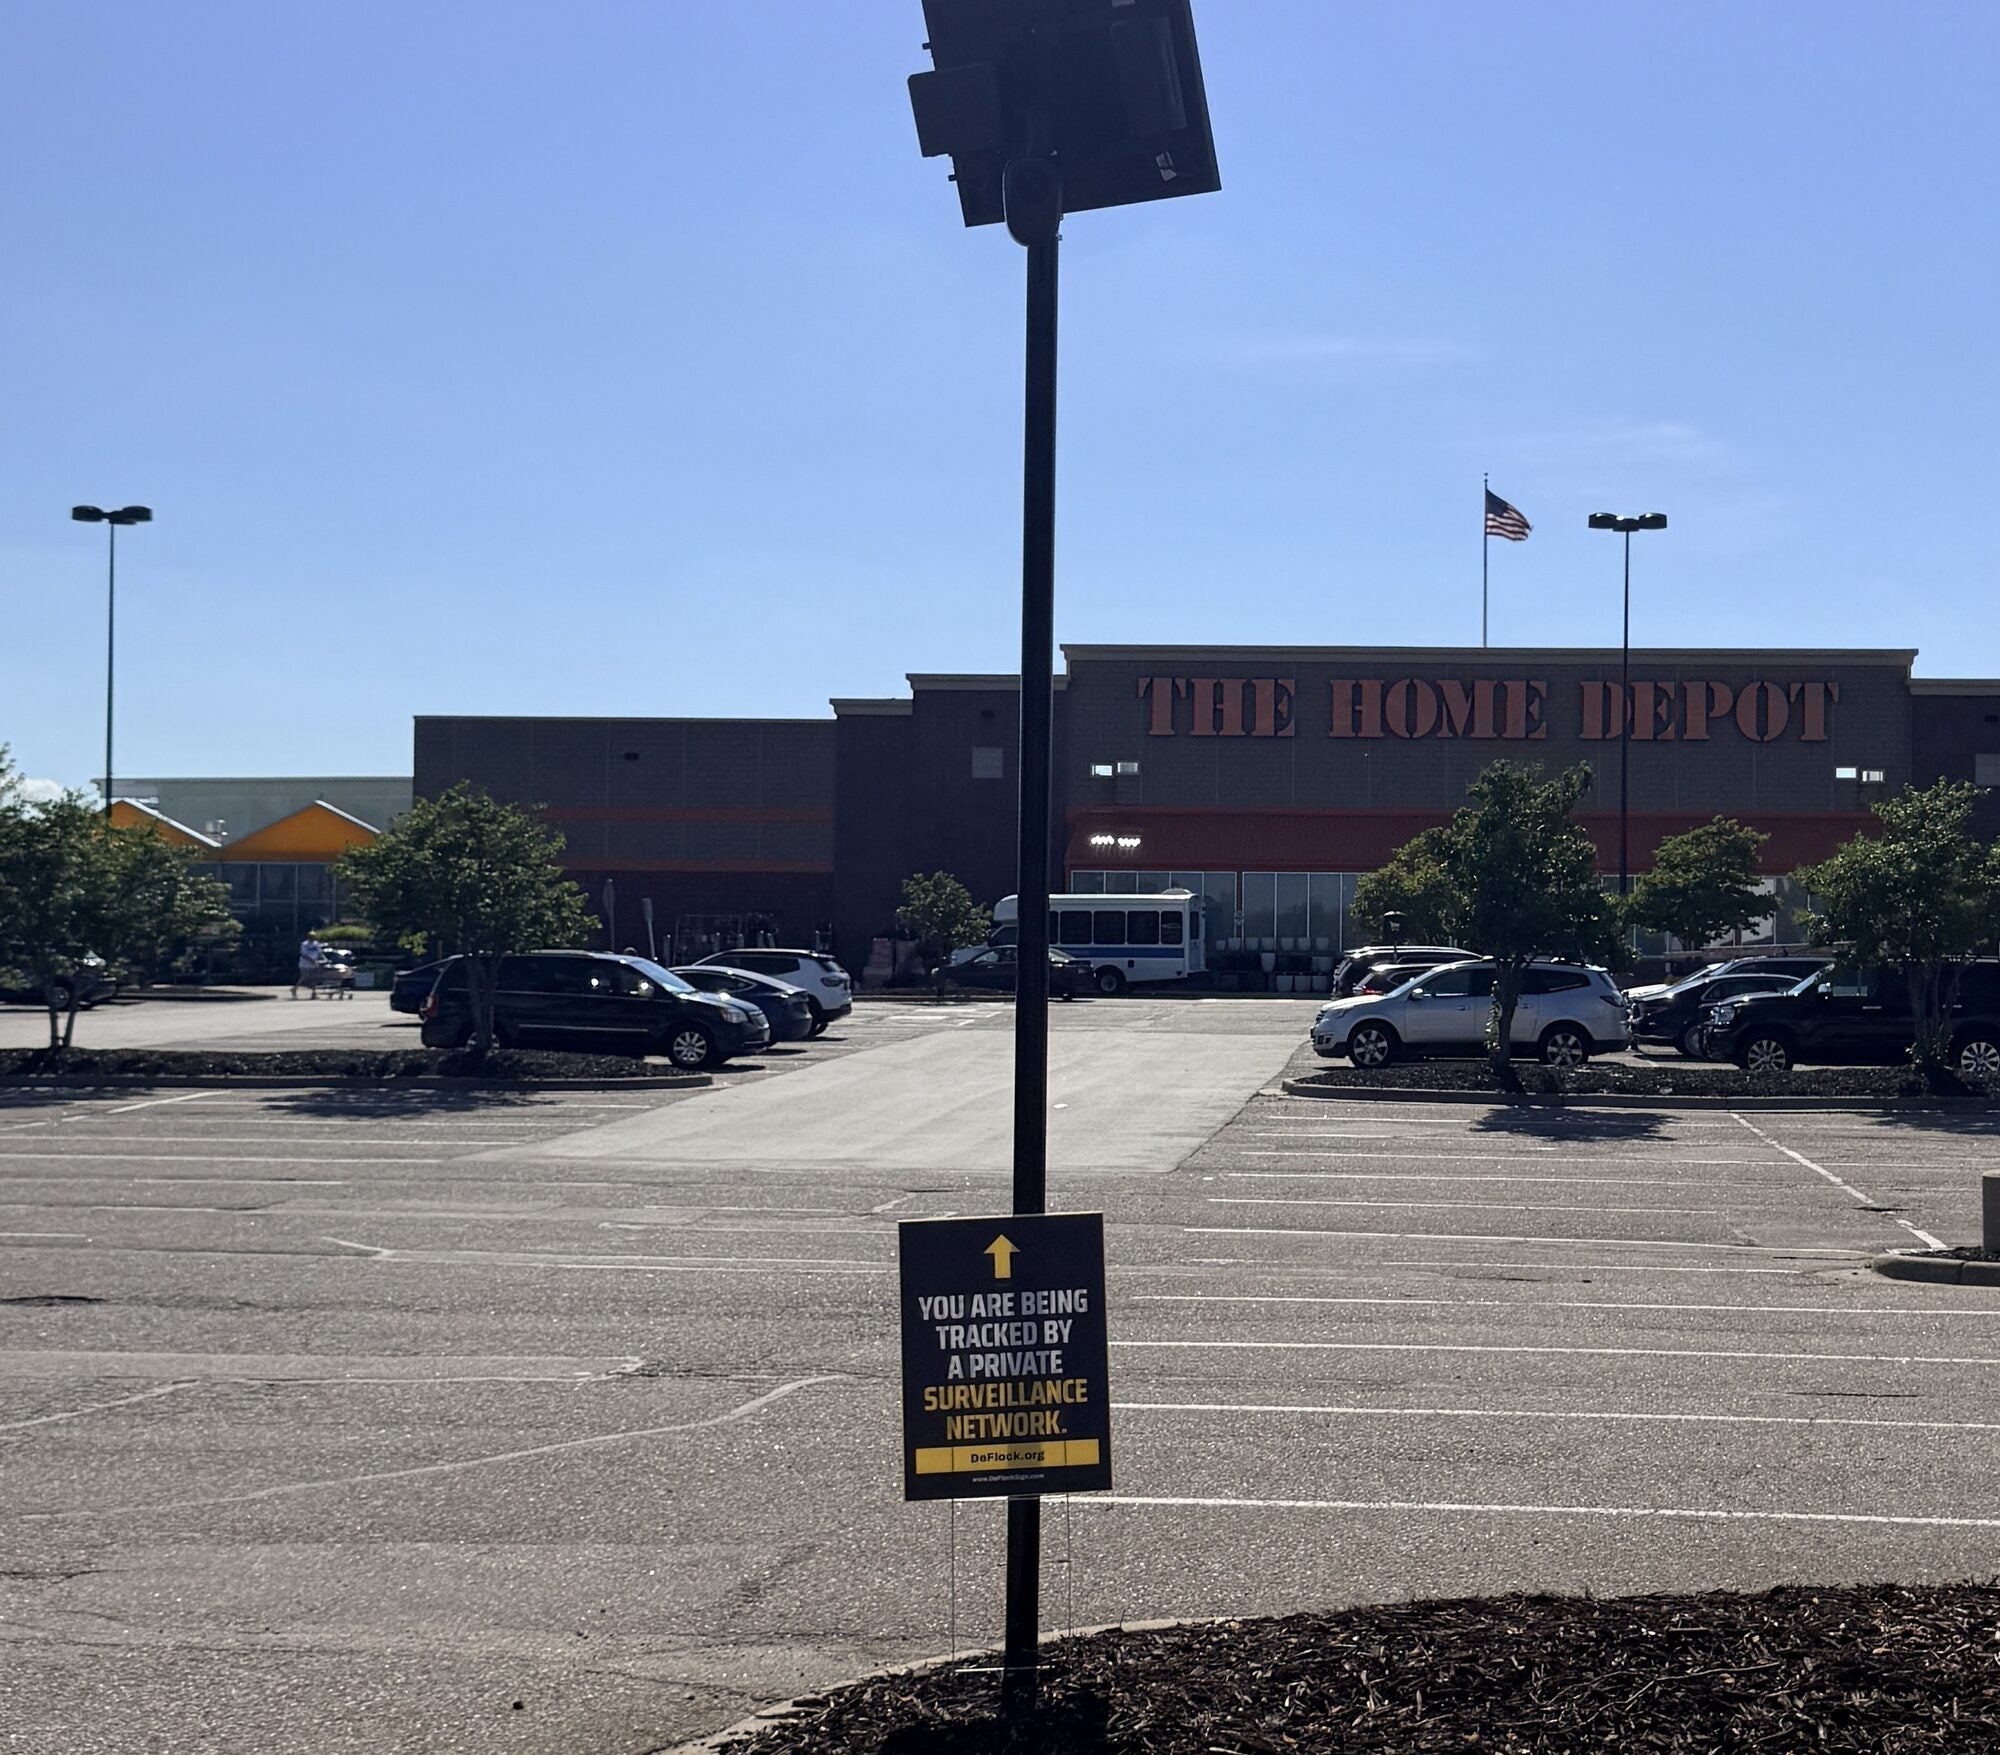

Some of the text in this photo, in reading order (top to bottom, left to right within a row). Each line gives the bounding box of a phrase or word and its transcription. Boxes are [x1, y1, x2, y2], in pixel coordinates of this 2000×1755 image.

[1138, 677, 1839, 741] THE HOME DEPOT
[918, 1289, 1089, 1321] YOU ARE BEING
[935, 1319, 1074, 1350] TRACKED BY
[947, 1350, 1064, 1380] A PRIVATE
[924, 1378, 1089, 1412] SURVEILLANCE
[946, 1410, 1068, 1441] NETWORK.
